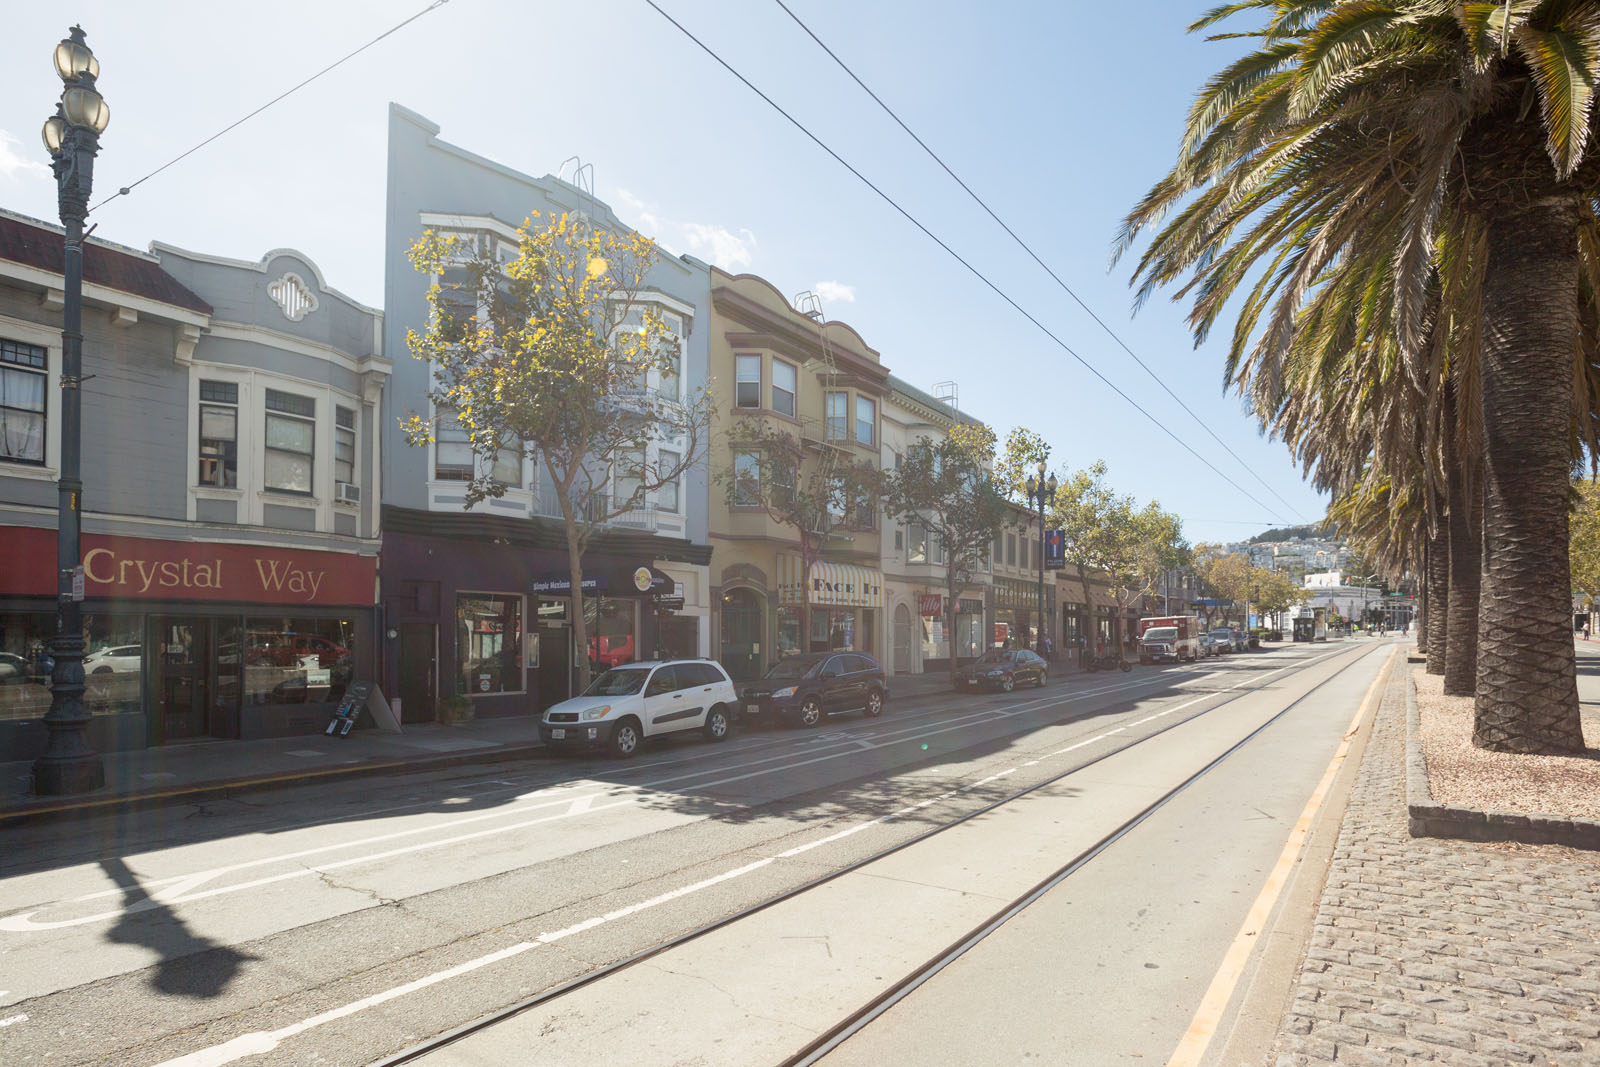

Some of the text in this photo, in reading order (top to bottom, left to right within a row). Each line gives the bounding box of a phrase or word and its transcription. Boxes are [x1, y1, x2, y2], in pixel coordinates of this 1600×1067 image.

[83, 548, 222, 593] Crystal
[255, 559, 325, 601] Way
[814, 579, 880, 595] FACE IT
[922, 597, 940, 613] illy
